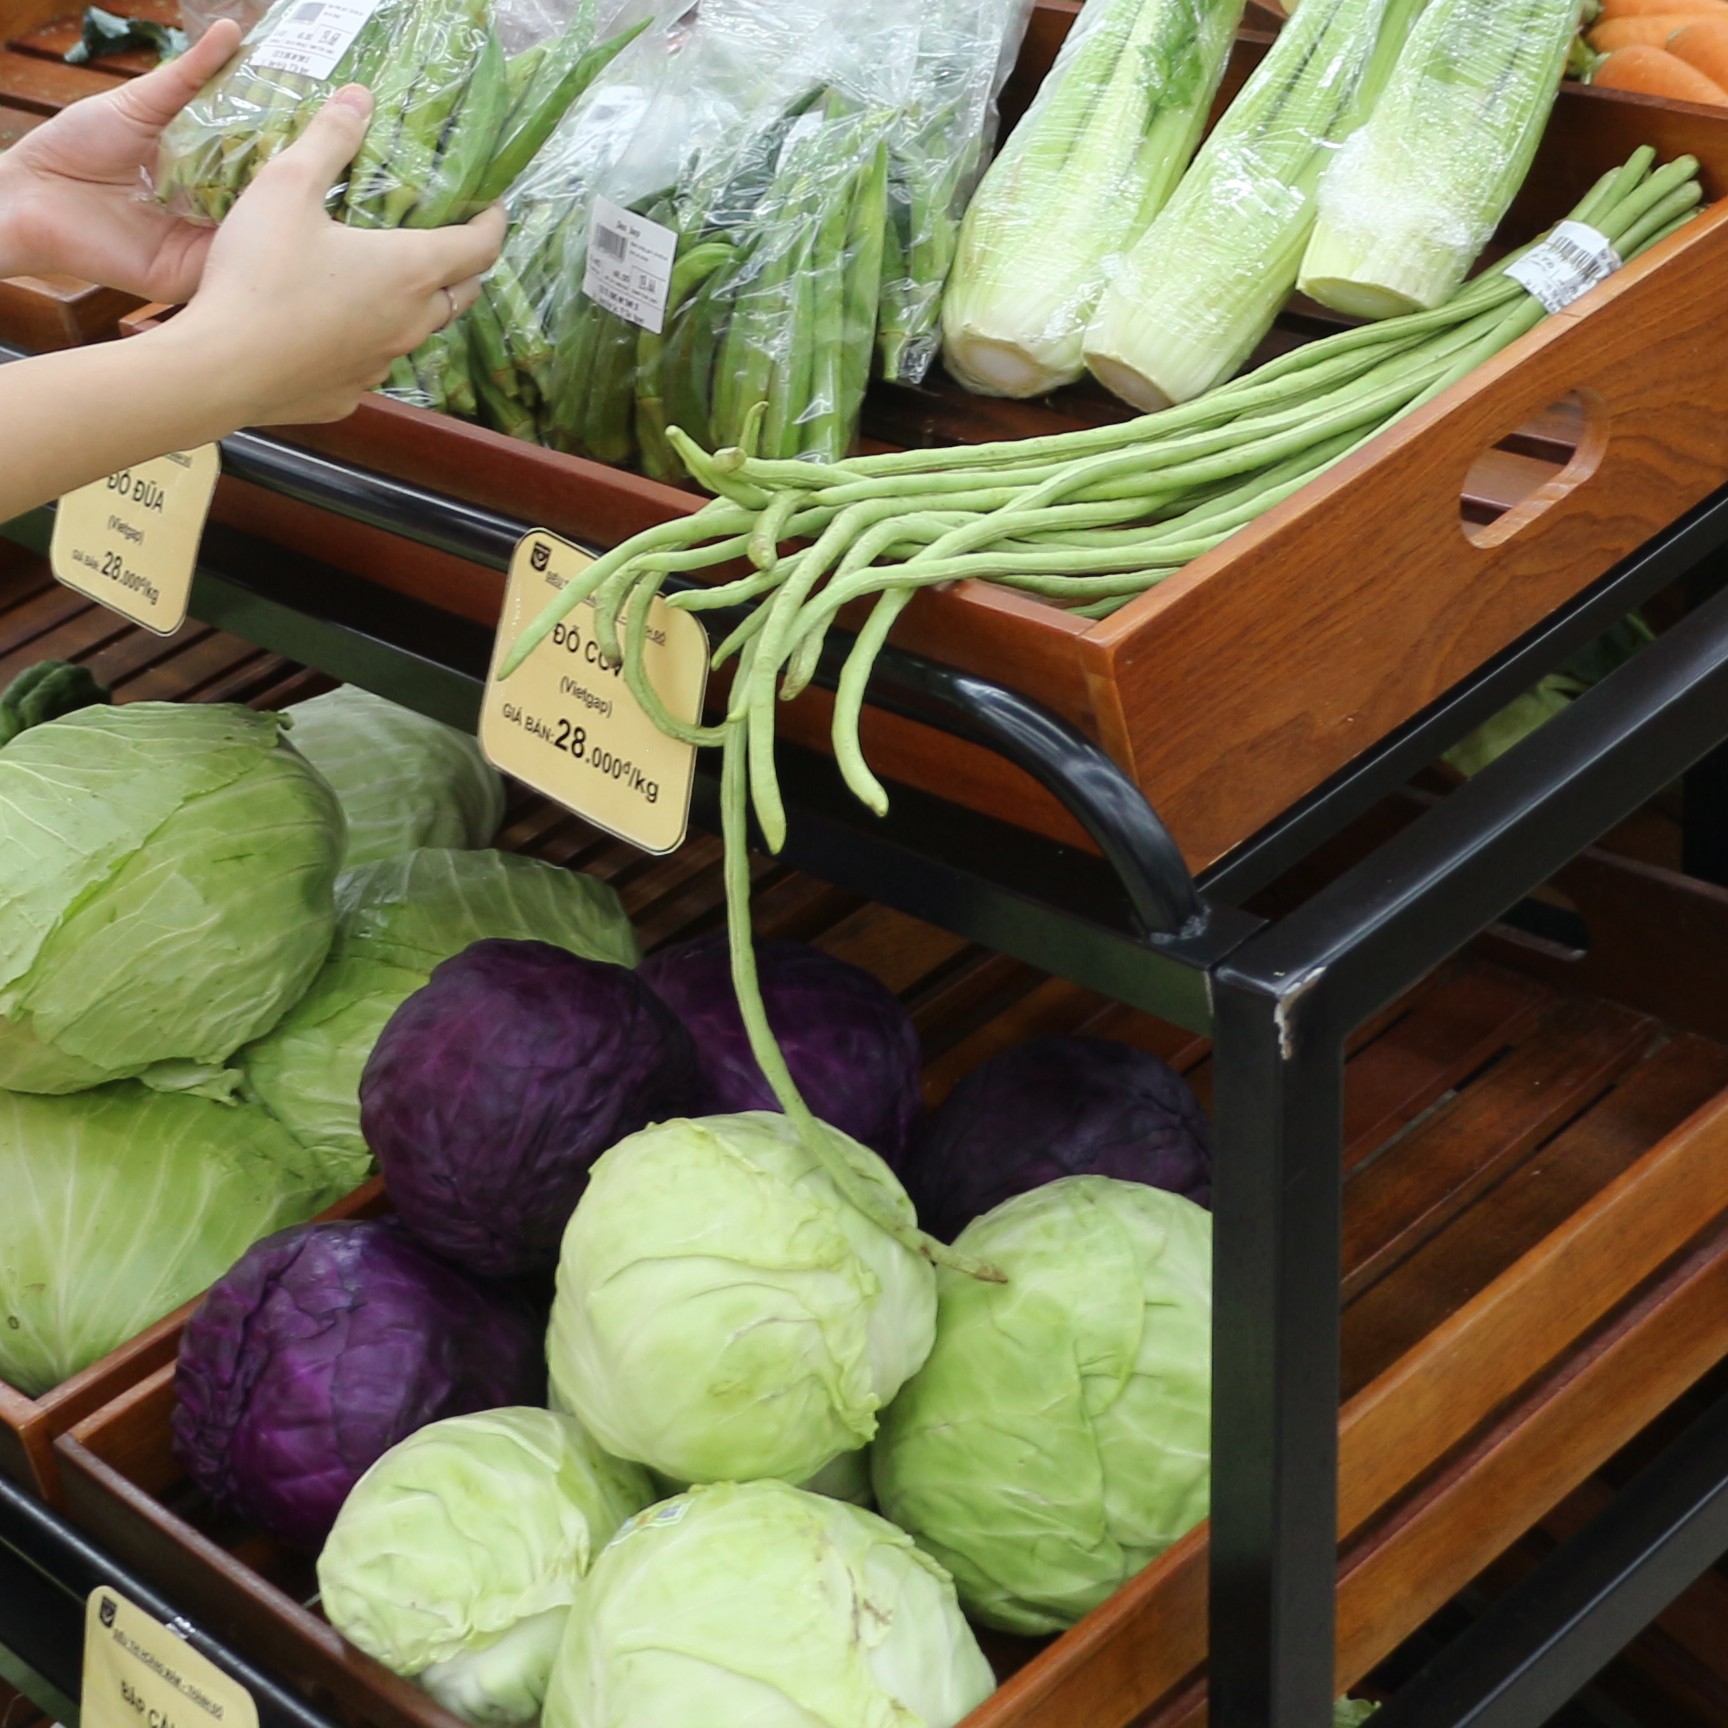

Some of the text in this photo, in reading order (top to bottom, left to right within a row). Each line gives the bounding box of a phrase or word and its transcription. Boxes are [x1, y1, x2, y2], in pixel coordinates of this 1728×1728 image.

[132, 479, 165, 513] ĐŨA
[552, 624, 580, 653] ĐỖ
[560, 675, 612, 719] (Vietgap)
[503, 702, 523, 727] GIÁ
